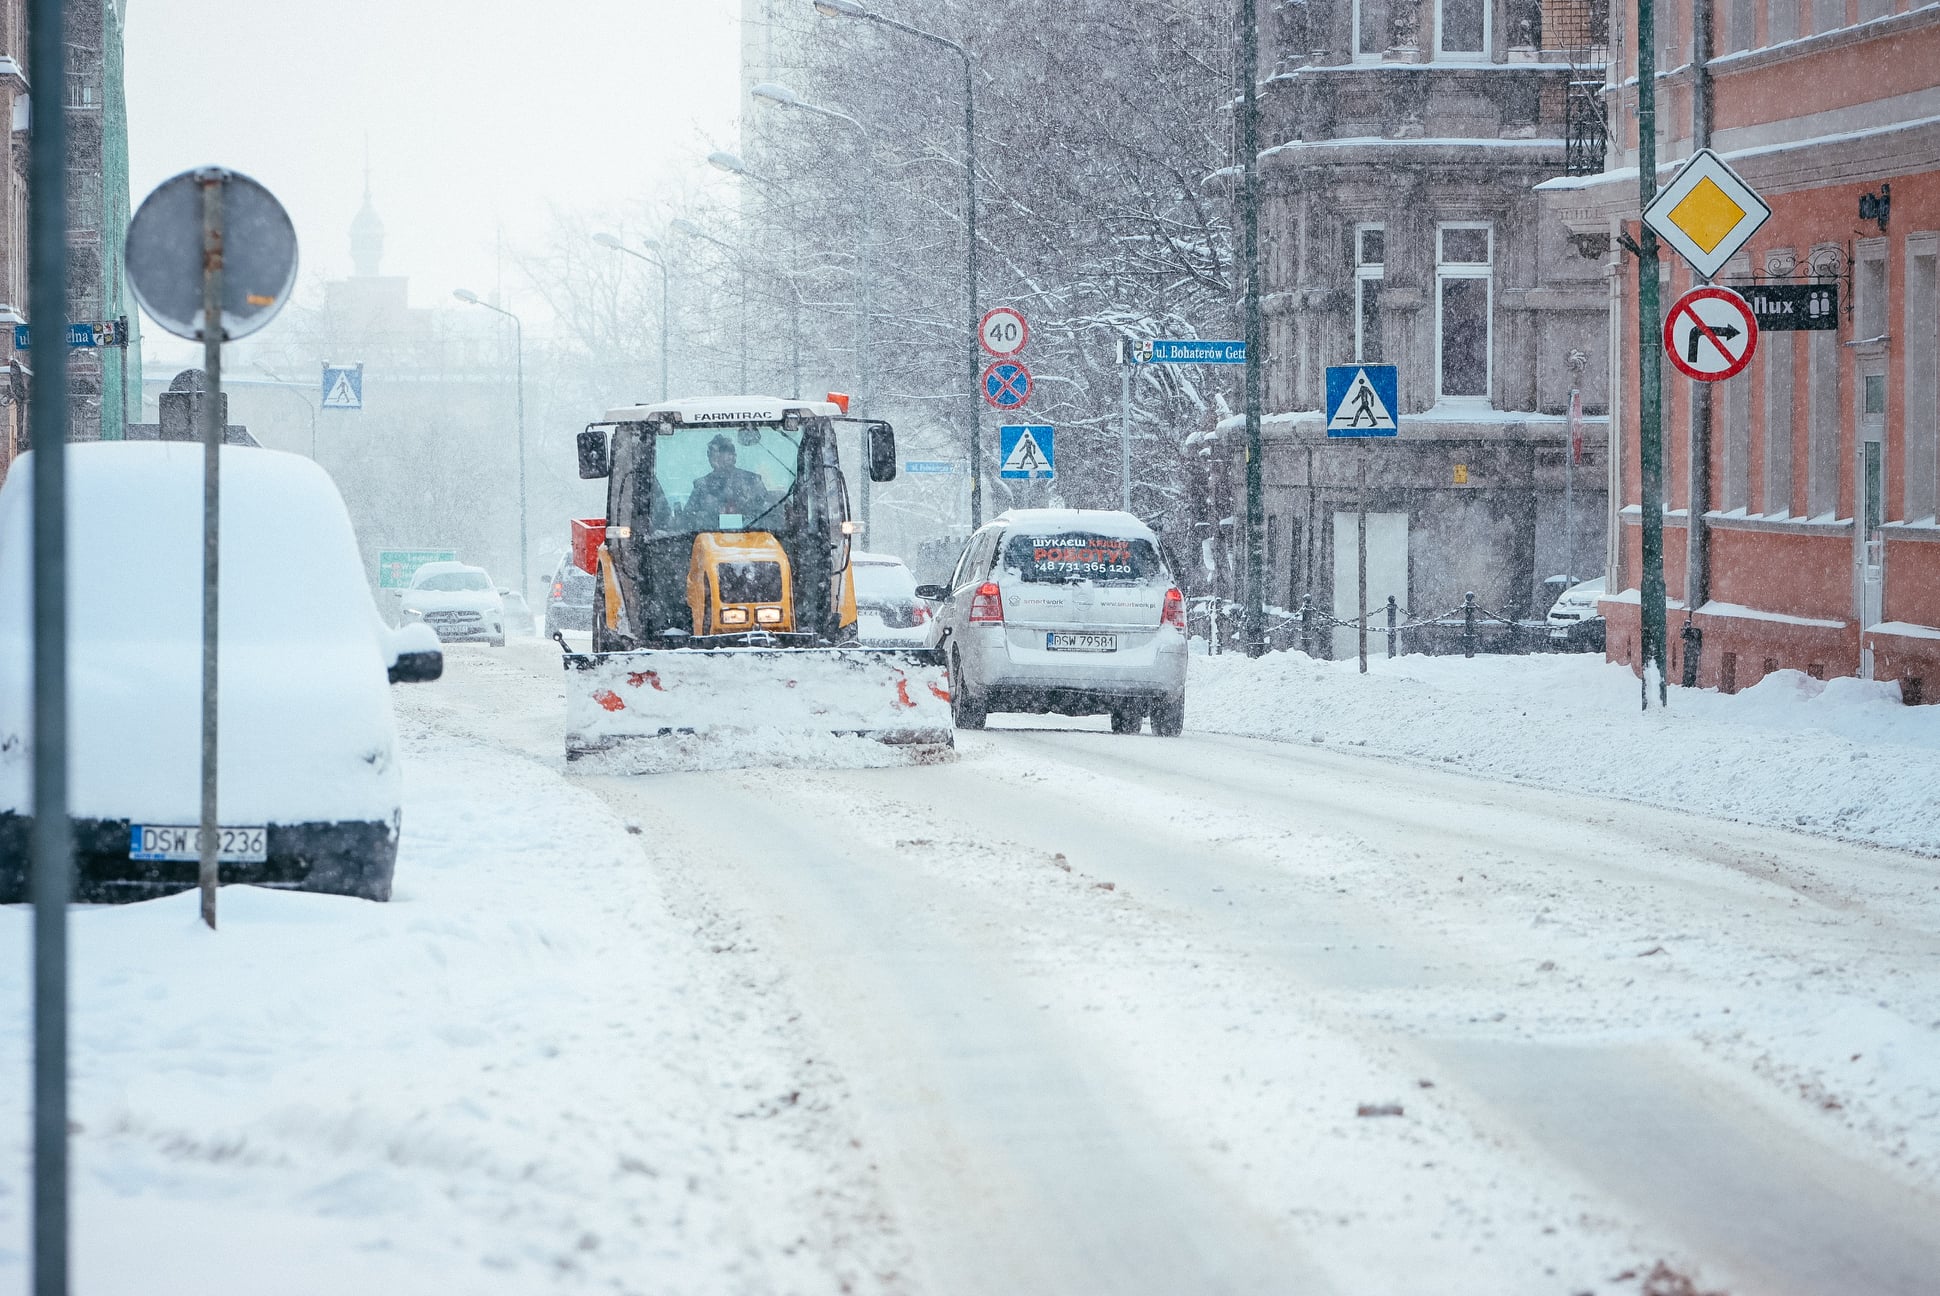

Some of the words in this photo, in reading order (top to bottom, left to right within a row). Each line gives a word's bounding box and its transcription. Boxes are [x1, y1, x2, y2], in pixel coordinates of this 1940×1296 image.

[1745, 296, 1794, 315] llux
[989, 322, 1018, 342] 40
[1155, 345, 1168, 359] ul.
[1170, 345, 1223, 359] Bohaterów
[694, 411, 773, 421] FARMTRAC
[1033, 539, 1086, 547] ШУКАЄШ
[1033, 547, 1131, 566] РОБОТУ?
[1034, 561, 1055, 572] +48
[1058, 562, 1080, 572] 731
[1083, 562, 1107, 574] 365
[1109, 565, 1132, 574] 120
[1054, 636, 1077, 646] DSW
[1079, 637, 1114, 648] 79581
[143, 828, 188, 852] DSW
